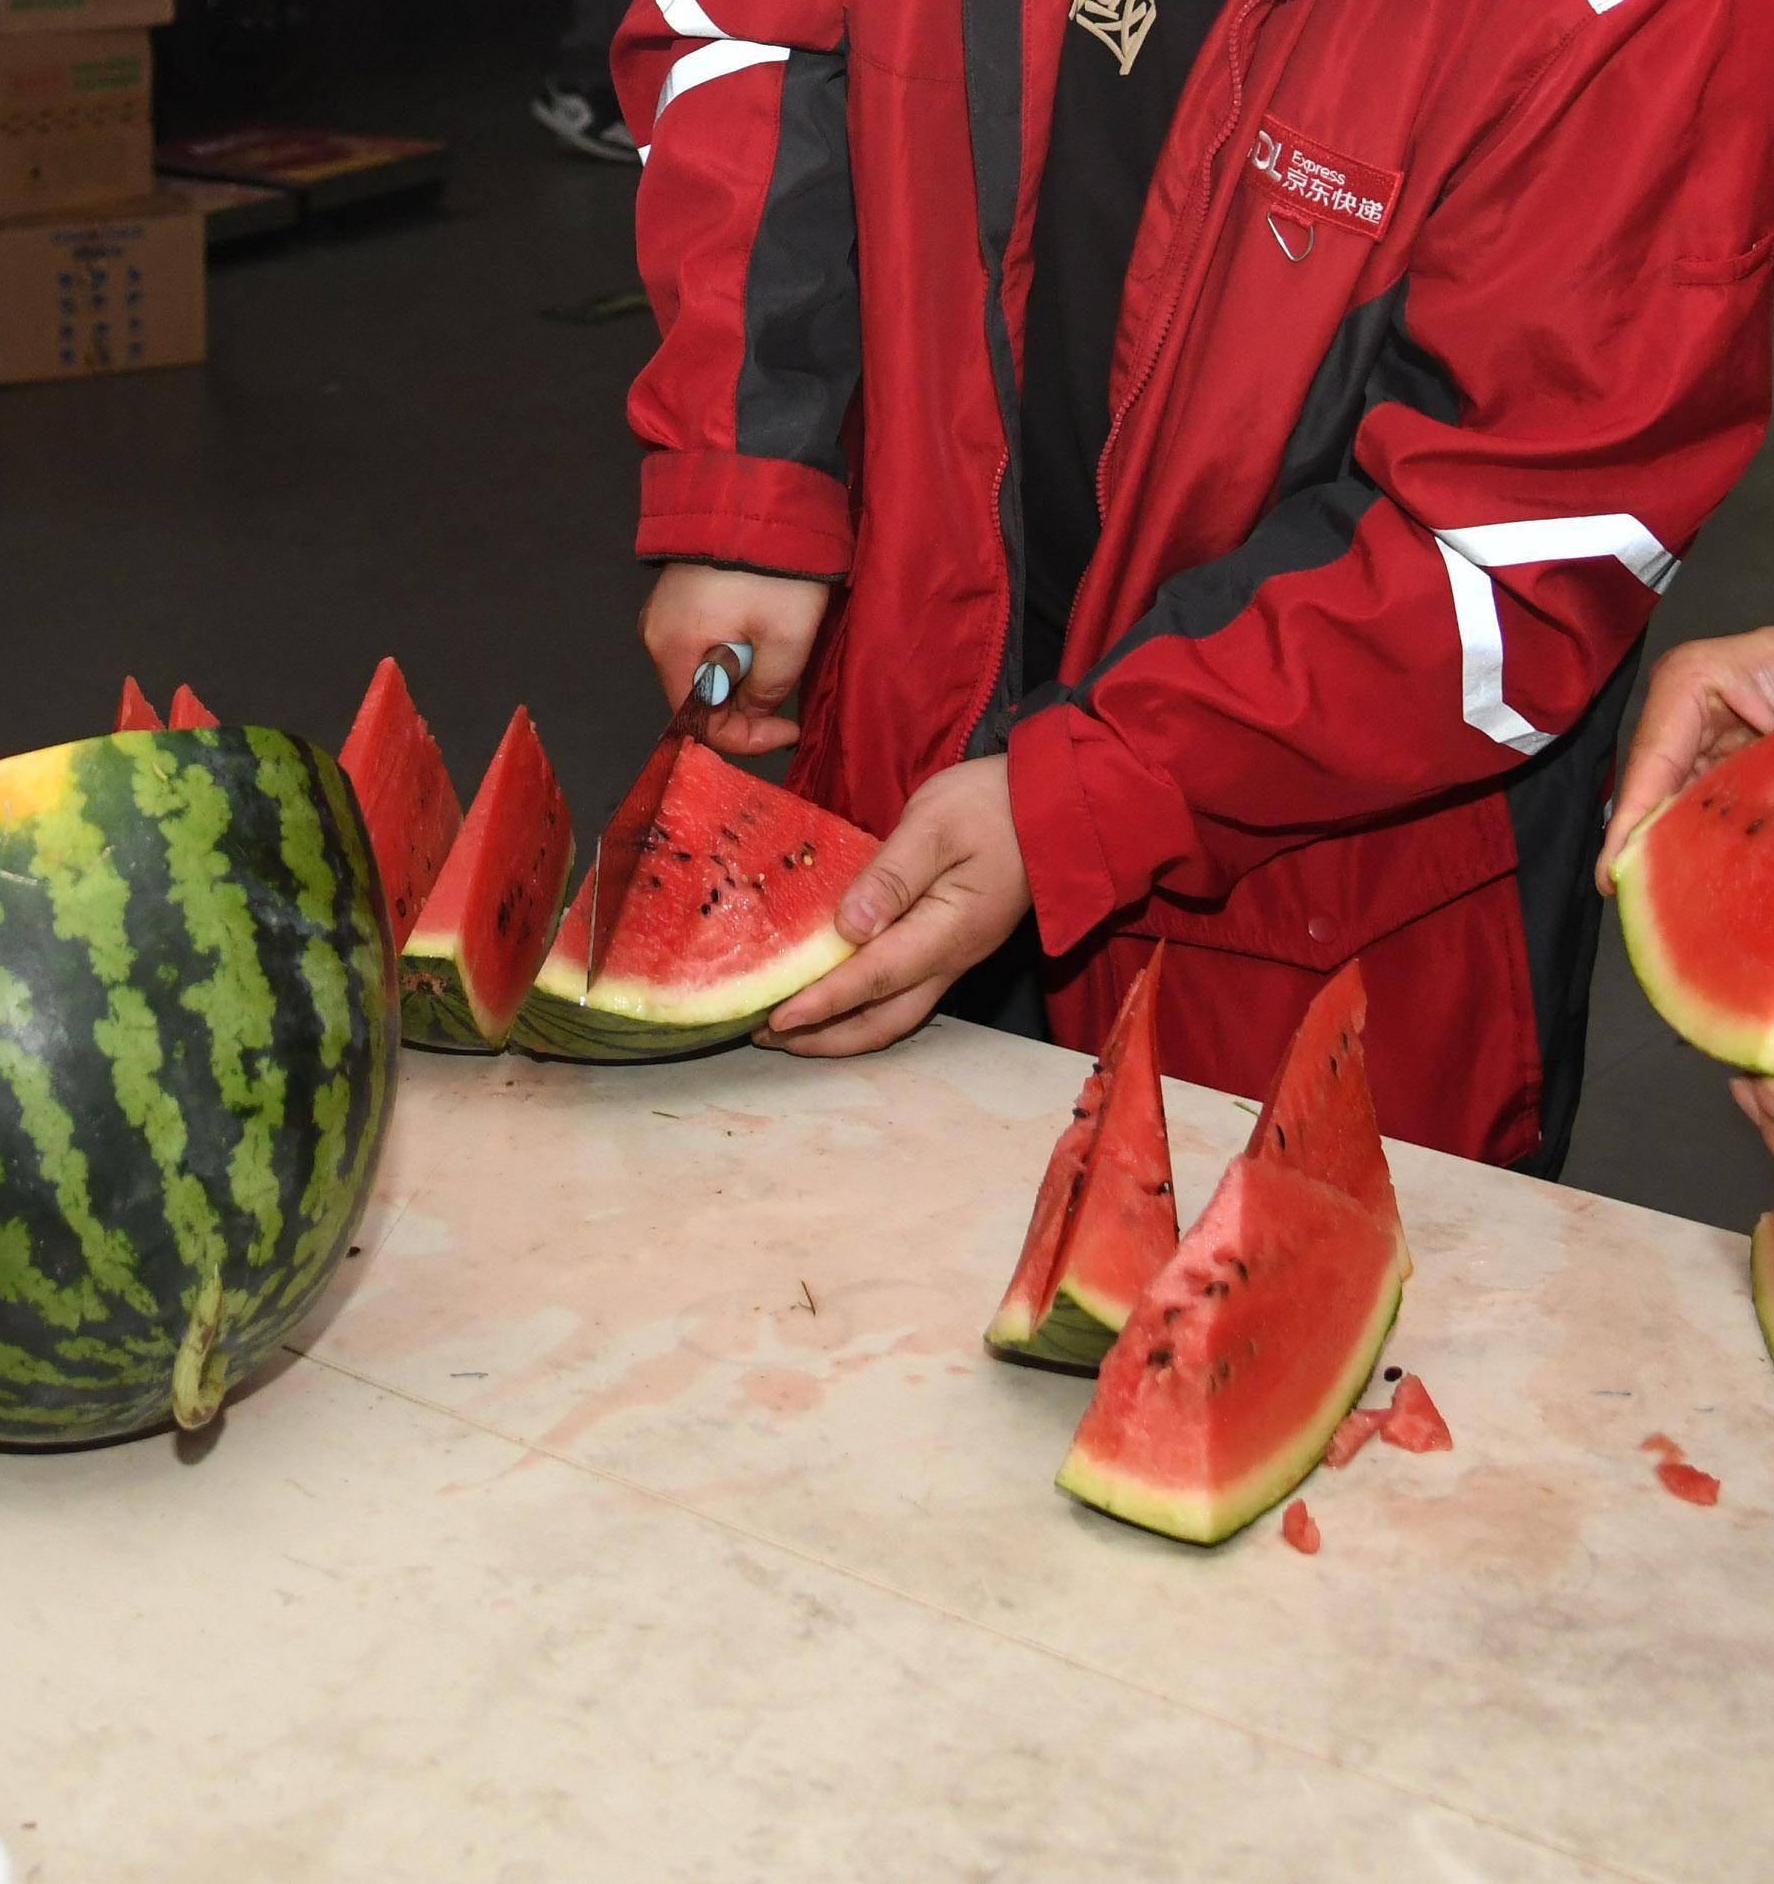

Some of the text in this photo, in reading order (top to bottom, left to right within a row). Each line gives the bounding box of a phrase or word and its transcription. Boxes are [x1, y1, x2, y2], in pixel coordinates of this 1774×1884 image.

[1246, 129, 1283, 182] DL
[1290, 149, 1347, 187] Express
[1281, 167, 1385, 226] 京东快递
